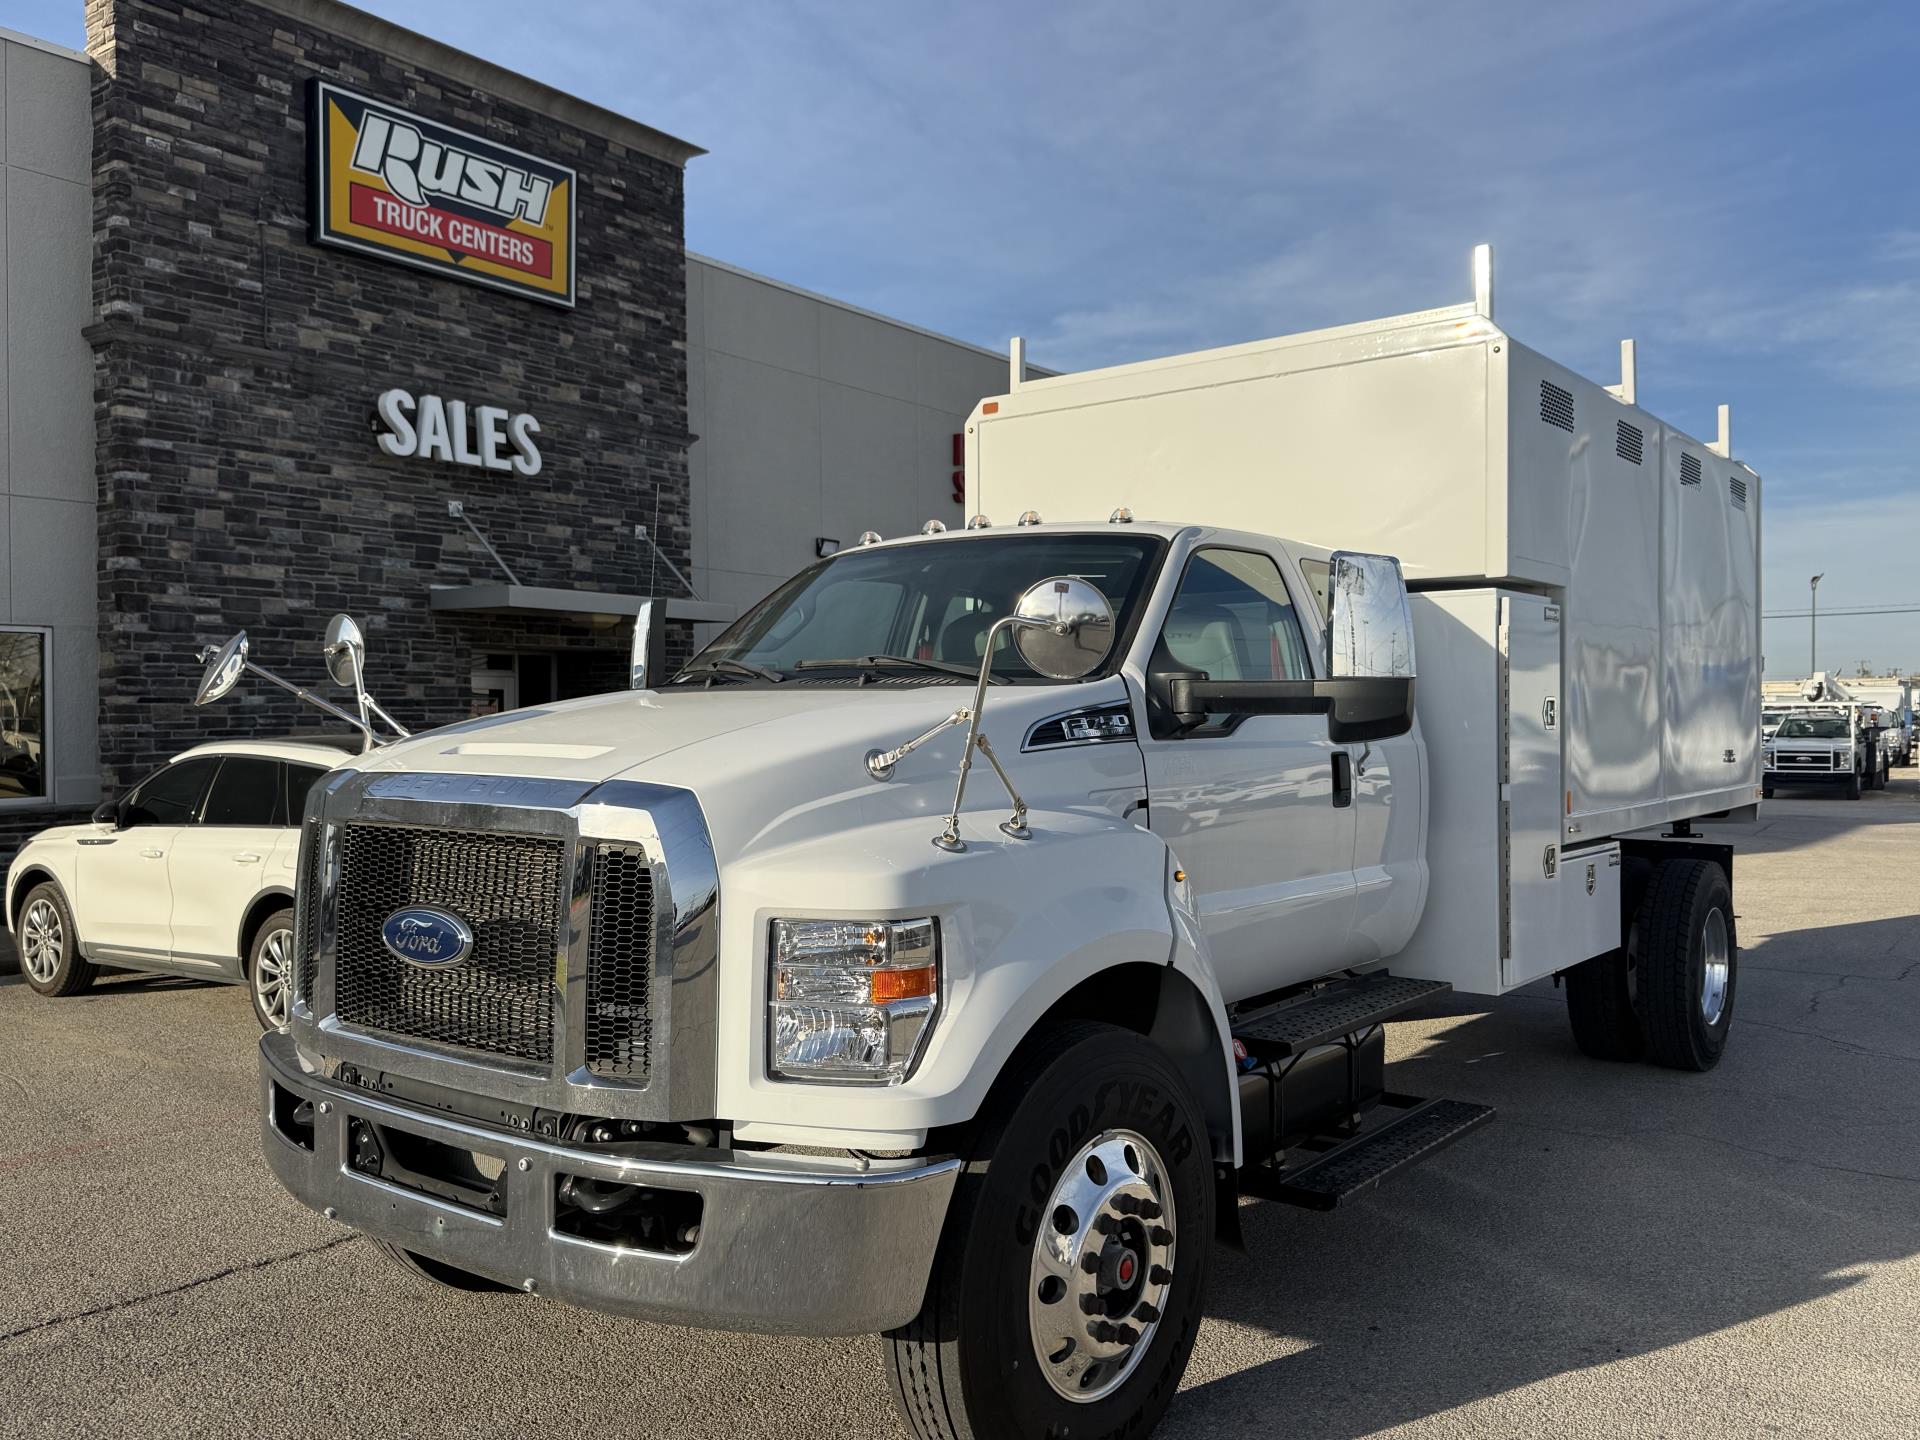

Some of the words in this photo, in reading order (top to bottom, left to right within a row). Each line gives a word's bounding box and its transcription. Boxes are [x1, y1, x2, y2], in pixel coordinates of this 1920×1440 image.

[373, 197, 443, 240] TRUCK
[449, 221, 534, 265] CENTERS
[377, 388, 543, 476] SALES
[396, 918, 442, 954] Ford
[1014, 1080, 1194, 1247] GOODYEAR
